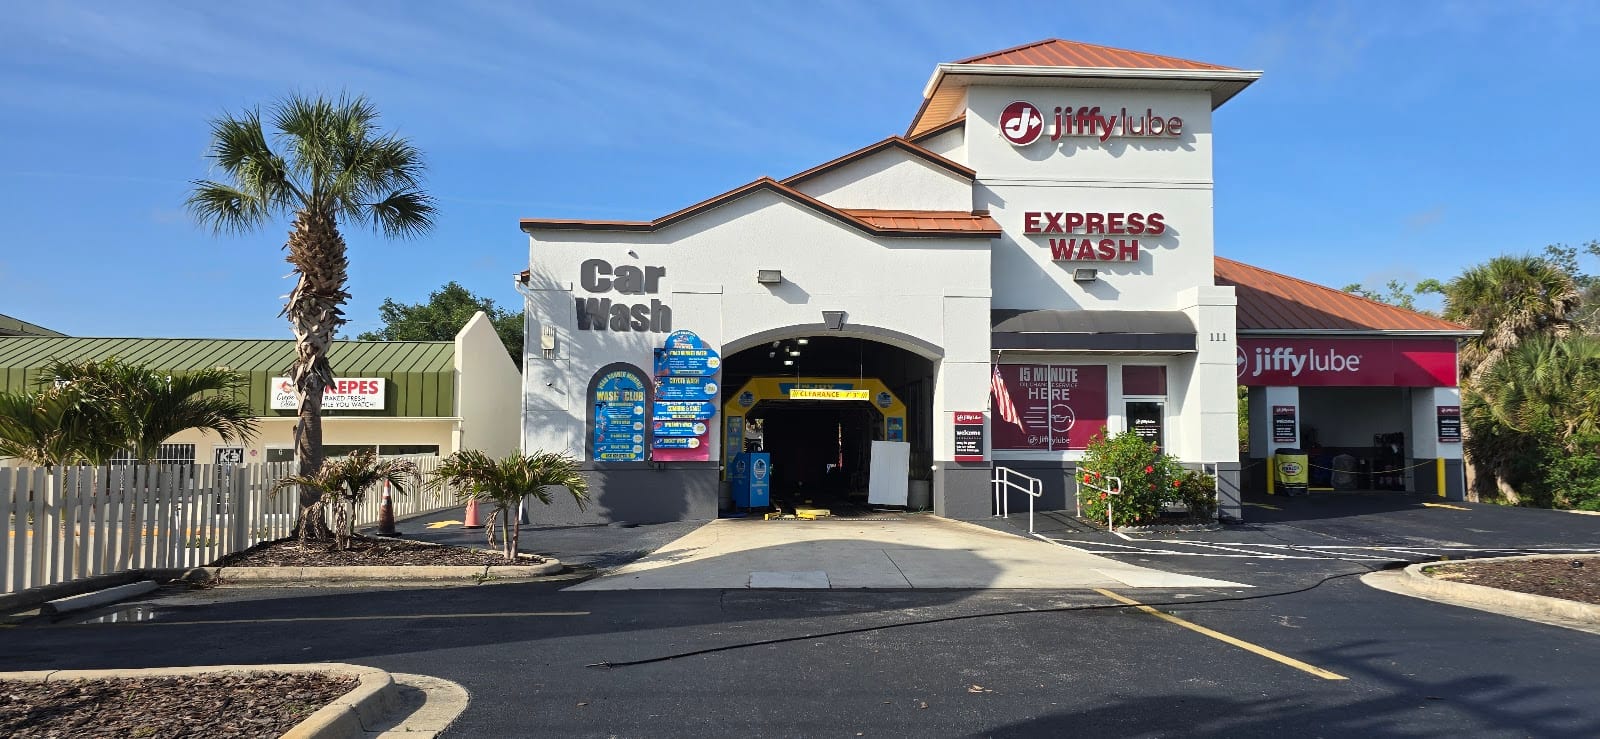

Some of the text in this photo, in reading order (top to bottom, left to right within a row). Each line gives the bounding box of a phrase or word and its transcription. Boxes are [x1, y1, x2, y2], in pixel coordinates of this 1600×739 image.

[1024, 211, 1166, 235] EXPRESS
[1049, 238, 1140, 261] WASH
[580, 258, 666, 295] Car
[575, 297, 672, 333] Wash
[1209, 332, 1227, 342] 111
[1019, 367, 1078, 383] 15 MINUTE
[596, 391, 644, 402] WASH CLUB
[1028, 387, 1070, 401] HERE
